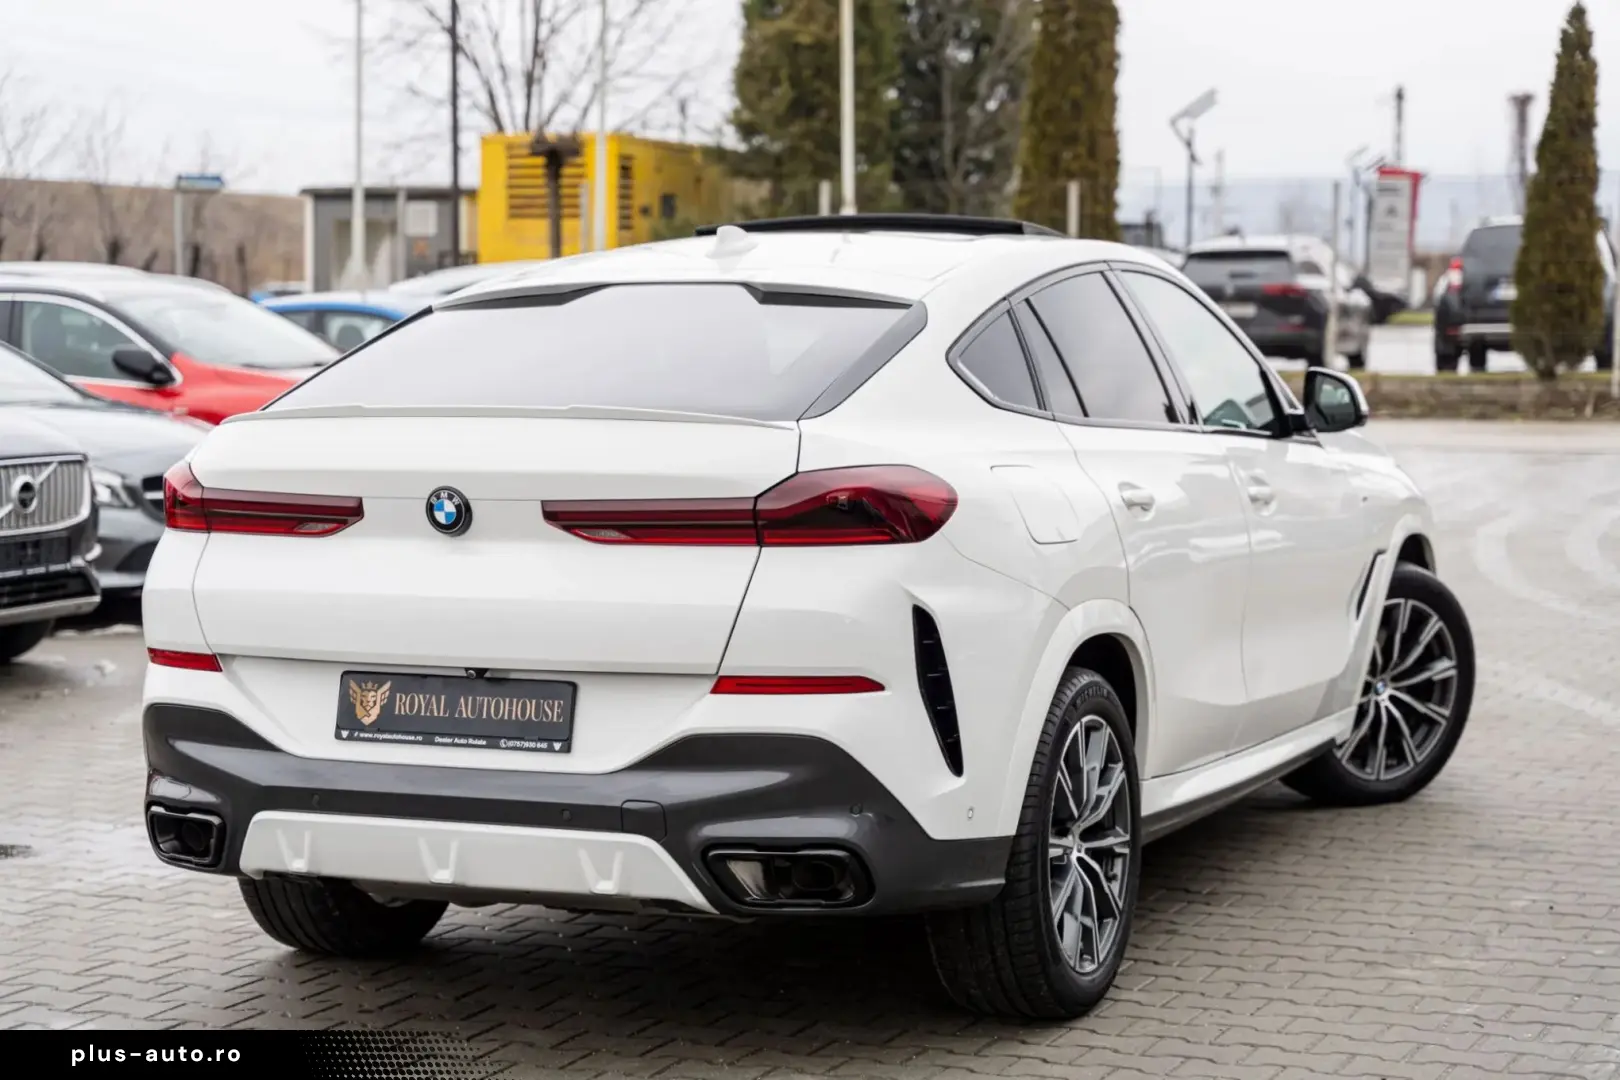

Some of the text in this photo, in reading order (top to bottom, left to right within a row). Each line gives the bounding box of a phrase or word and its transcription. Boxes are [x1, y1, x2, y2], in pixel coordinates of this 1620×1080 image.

[430, 491, 461, 506] BMW
[394, 692, 564, 723] ROYAL AUTOHOUSE
